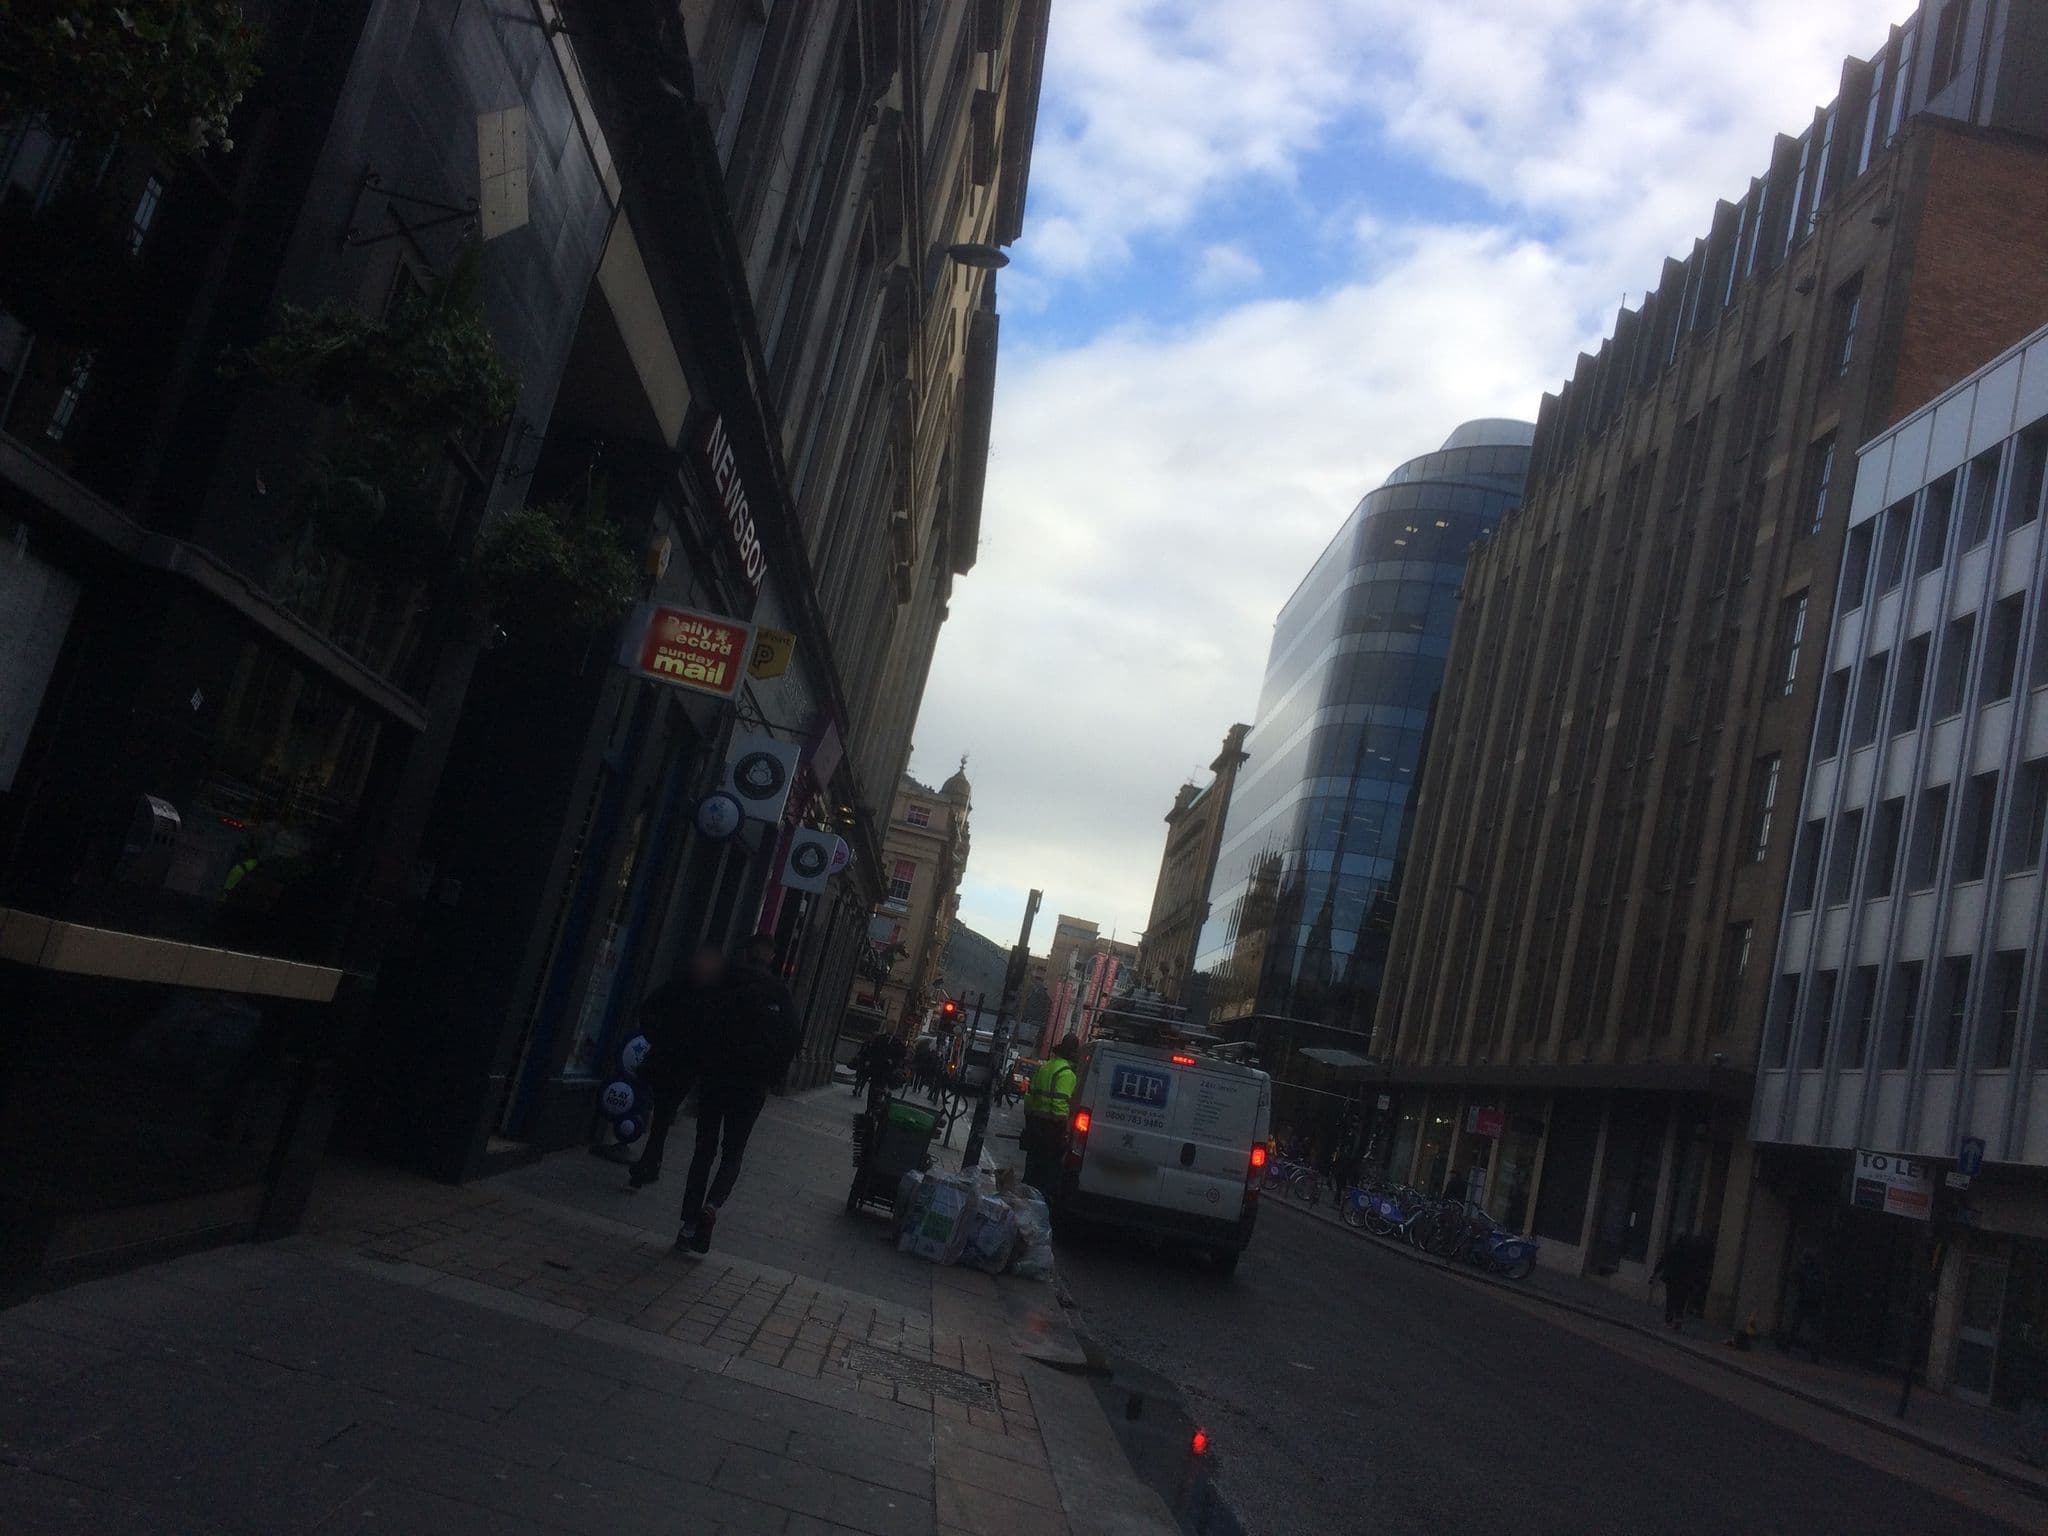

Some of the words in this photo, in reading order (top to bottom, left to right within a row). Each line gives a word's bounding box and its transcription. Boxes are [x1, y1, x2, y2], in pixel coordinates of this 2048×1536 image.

[706, 413, 768, 596] NEWSBOX
[665, 630, 733, 656] ecord
[658, 645, 716, 667] sunday
[653, 653, 728, 686] mail
[607, 1096, 627, 1107] NOW
[609, 1089, 630, 1098] PLAY
[1105, 1111, 1125, 1121] 0800
[1861, 1151, 1888, 1171] TO
[1896, 1159, 1929, 1180] LET
